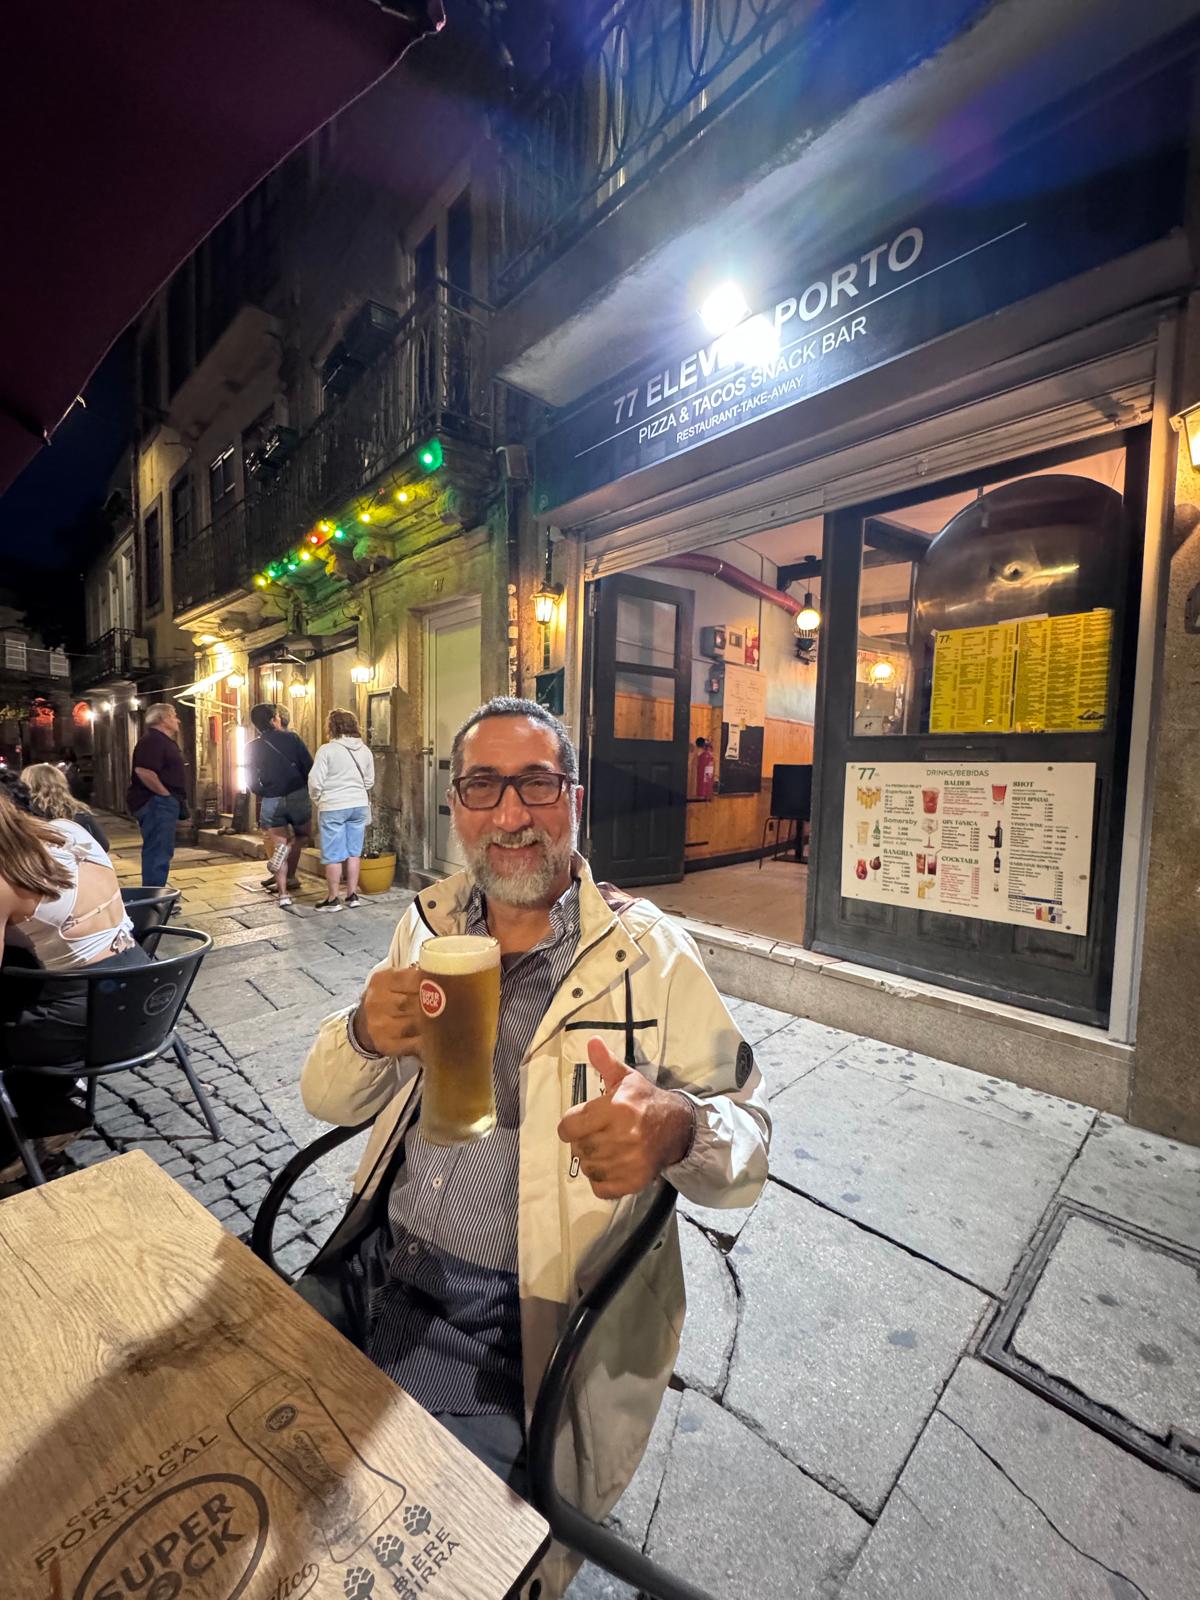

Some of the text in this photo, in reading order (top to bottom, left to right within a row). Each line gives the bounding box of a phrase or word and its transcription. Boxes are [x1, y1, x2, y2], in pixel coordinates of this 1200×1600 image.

[613, 387, 639, 424] 77
[774, 227, 924, 334] PORTO
[638, 315, 867, 444] PIZZA & TACOS SNACK BAR
[676, 375, 804, 443] RESTAURANT-TAKE-AWAY
[939, 634, 950, 644] 77
[858, 767, 876, 781] 77
[926, 769, 990, 778] DRINKS/BEBIDAS
[34, 1433, 219, 1571] PORTUGAL
[65, 1438, 184, 1529] CERVEJA DE
[146, 1517, 246, 1600] OCK
